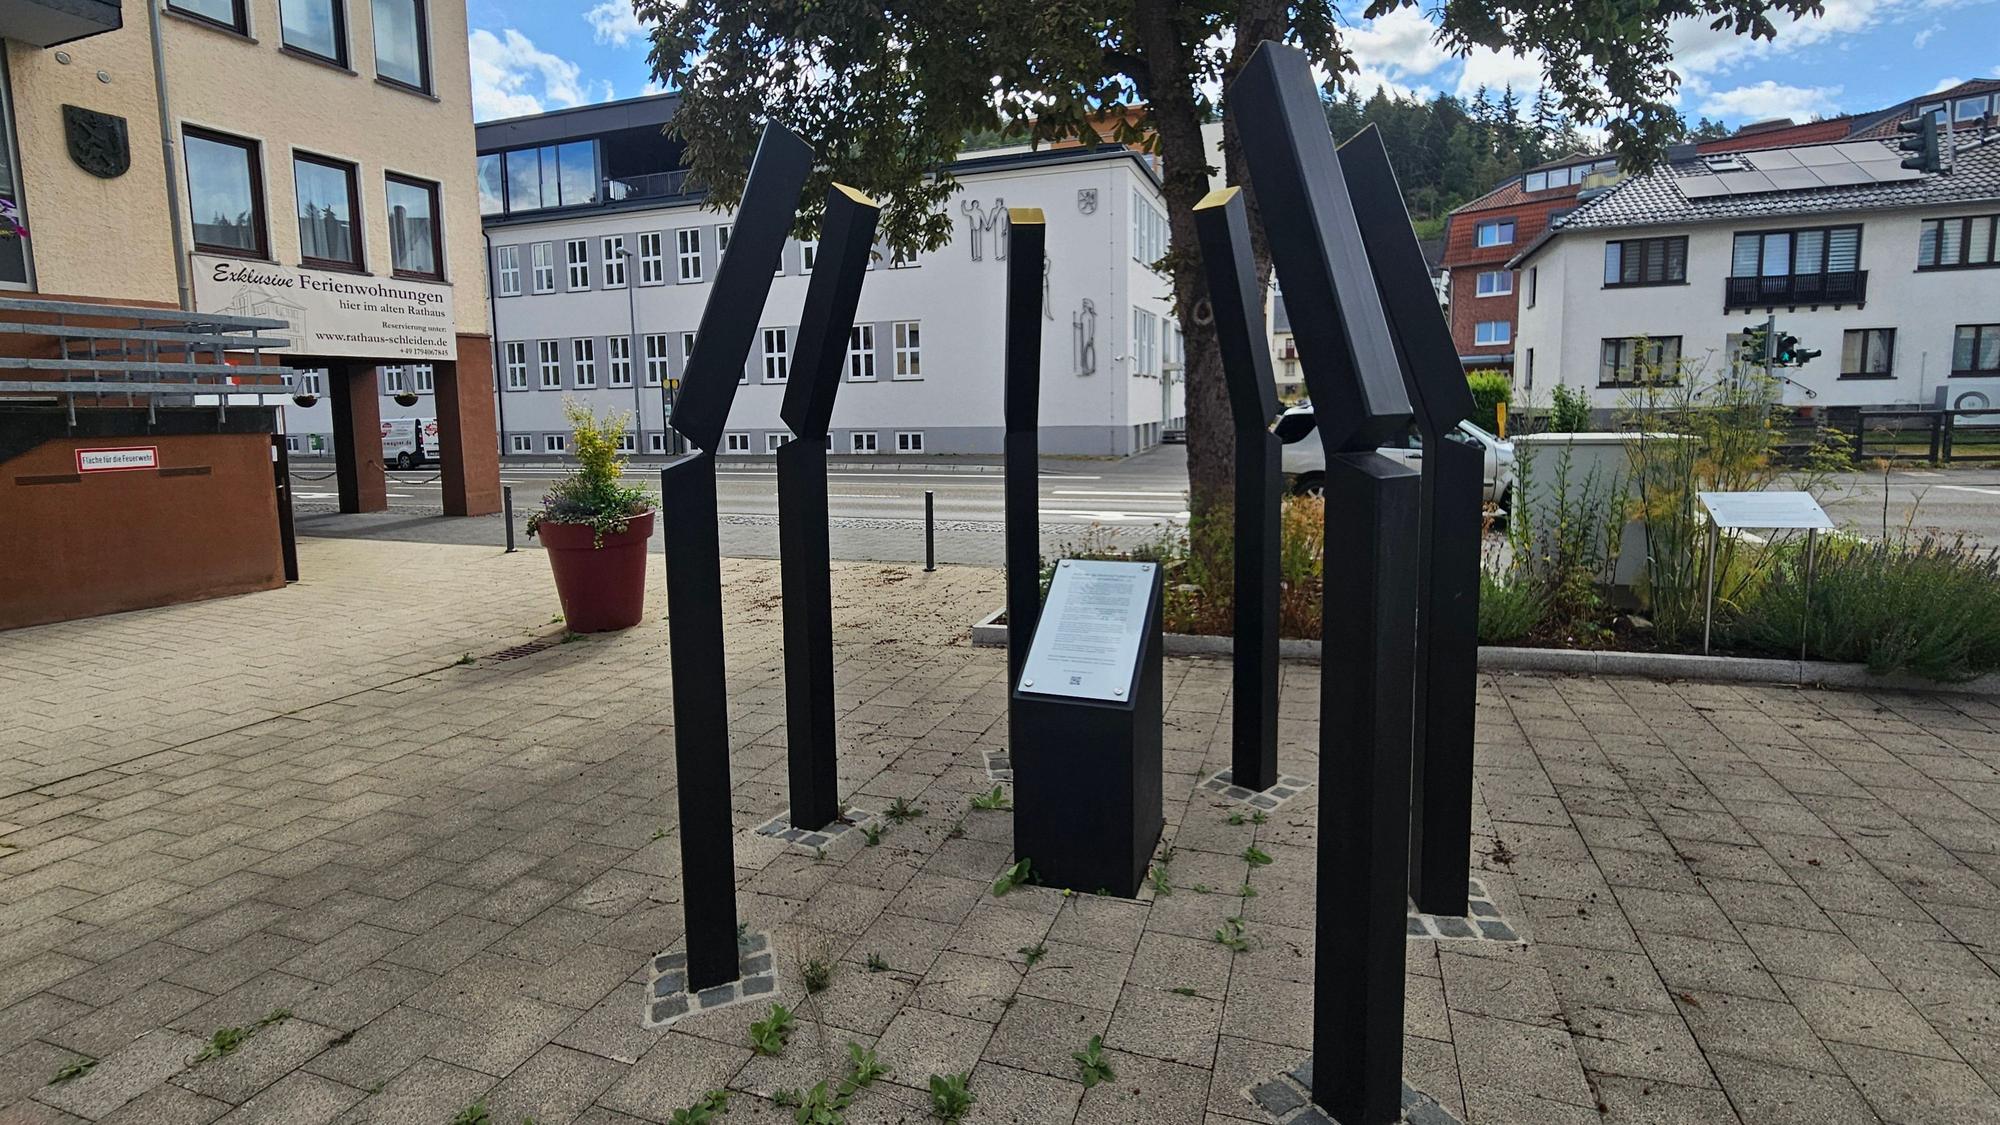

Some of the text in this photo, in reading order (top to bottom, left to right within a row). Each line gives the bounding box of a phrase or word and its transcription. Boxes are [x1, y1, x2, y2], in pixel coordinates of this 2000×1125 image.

[212, 263, 443, 306] Exklusive Ferienwohnungen
[339, 299, 446, 317] hier im alten Rathaus
[382, 321, 427, 333] Reservierung
[315, 332, 448, 347] www.rathaus-schleiden.de
[122, 454, 152, 462] Feuerwehr
